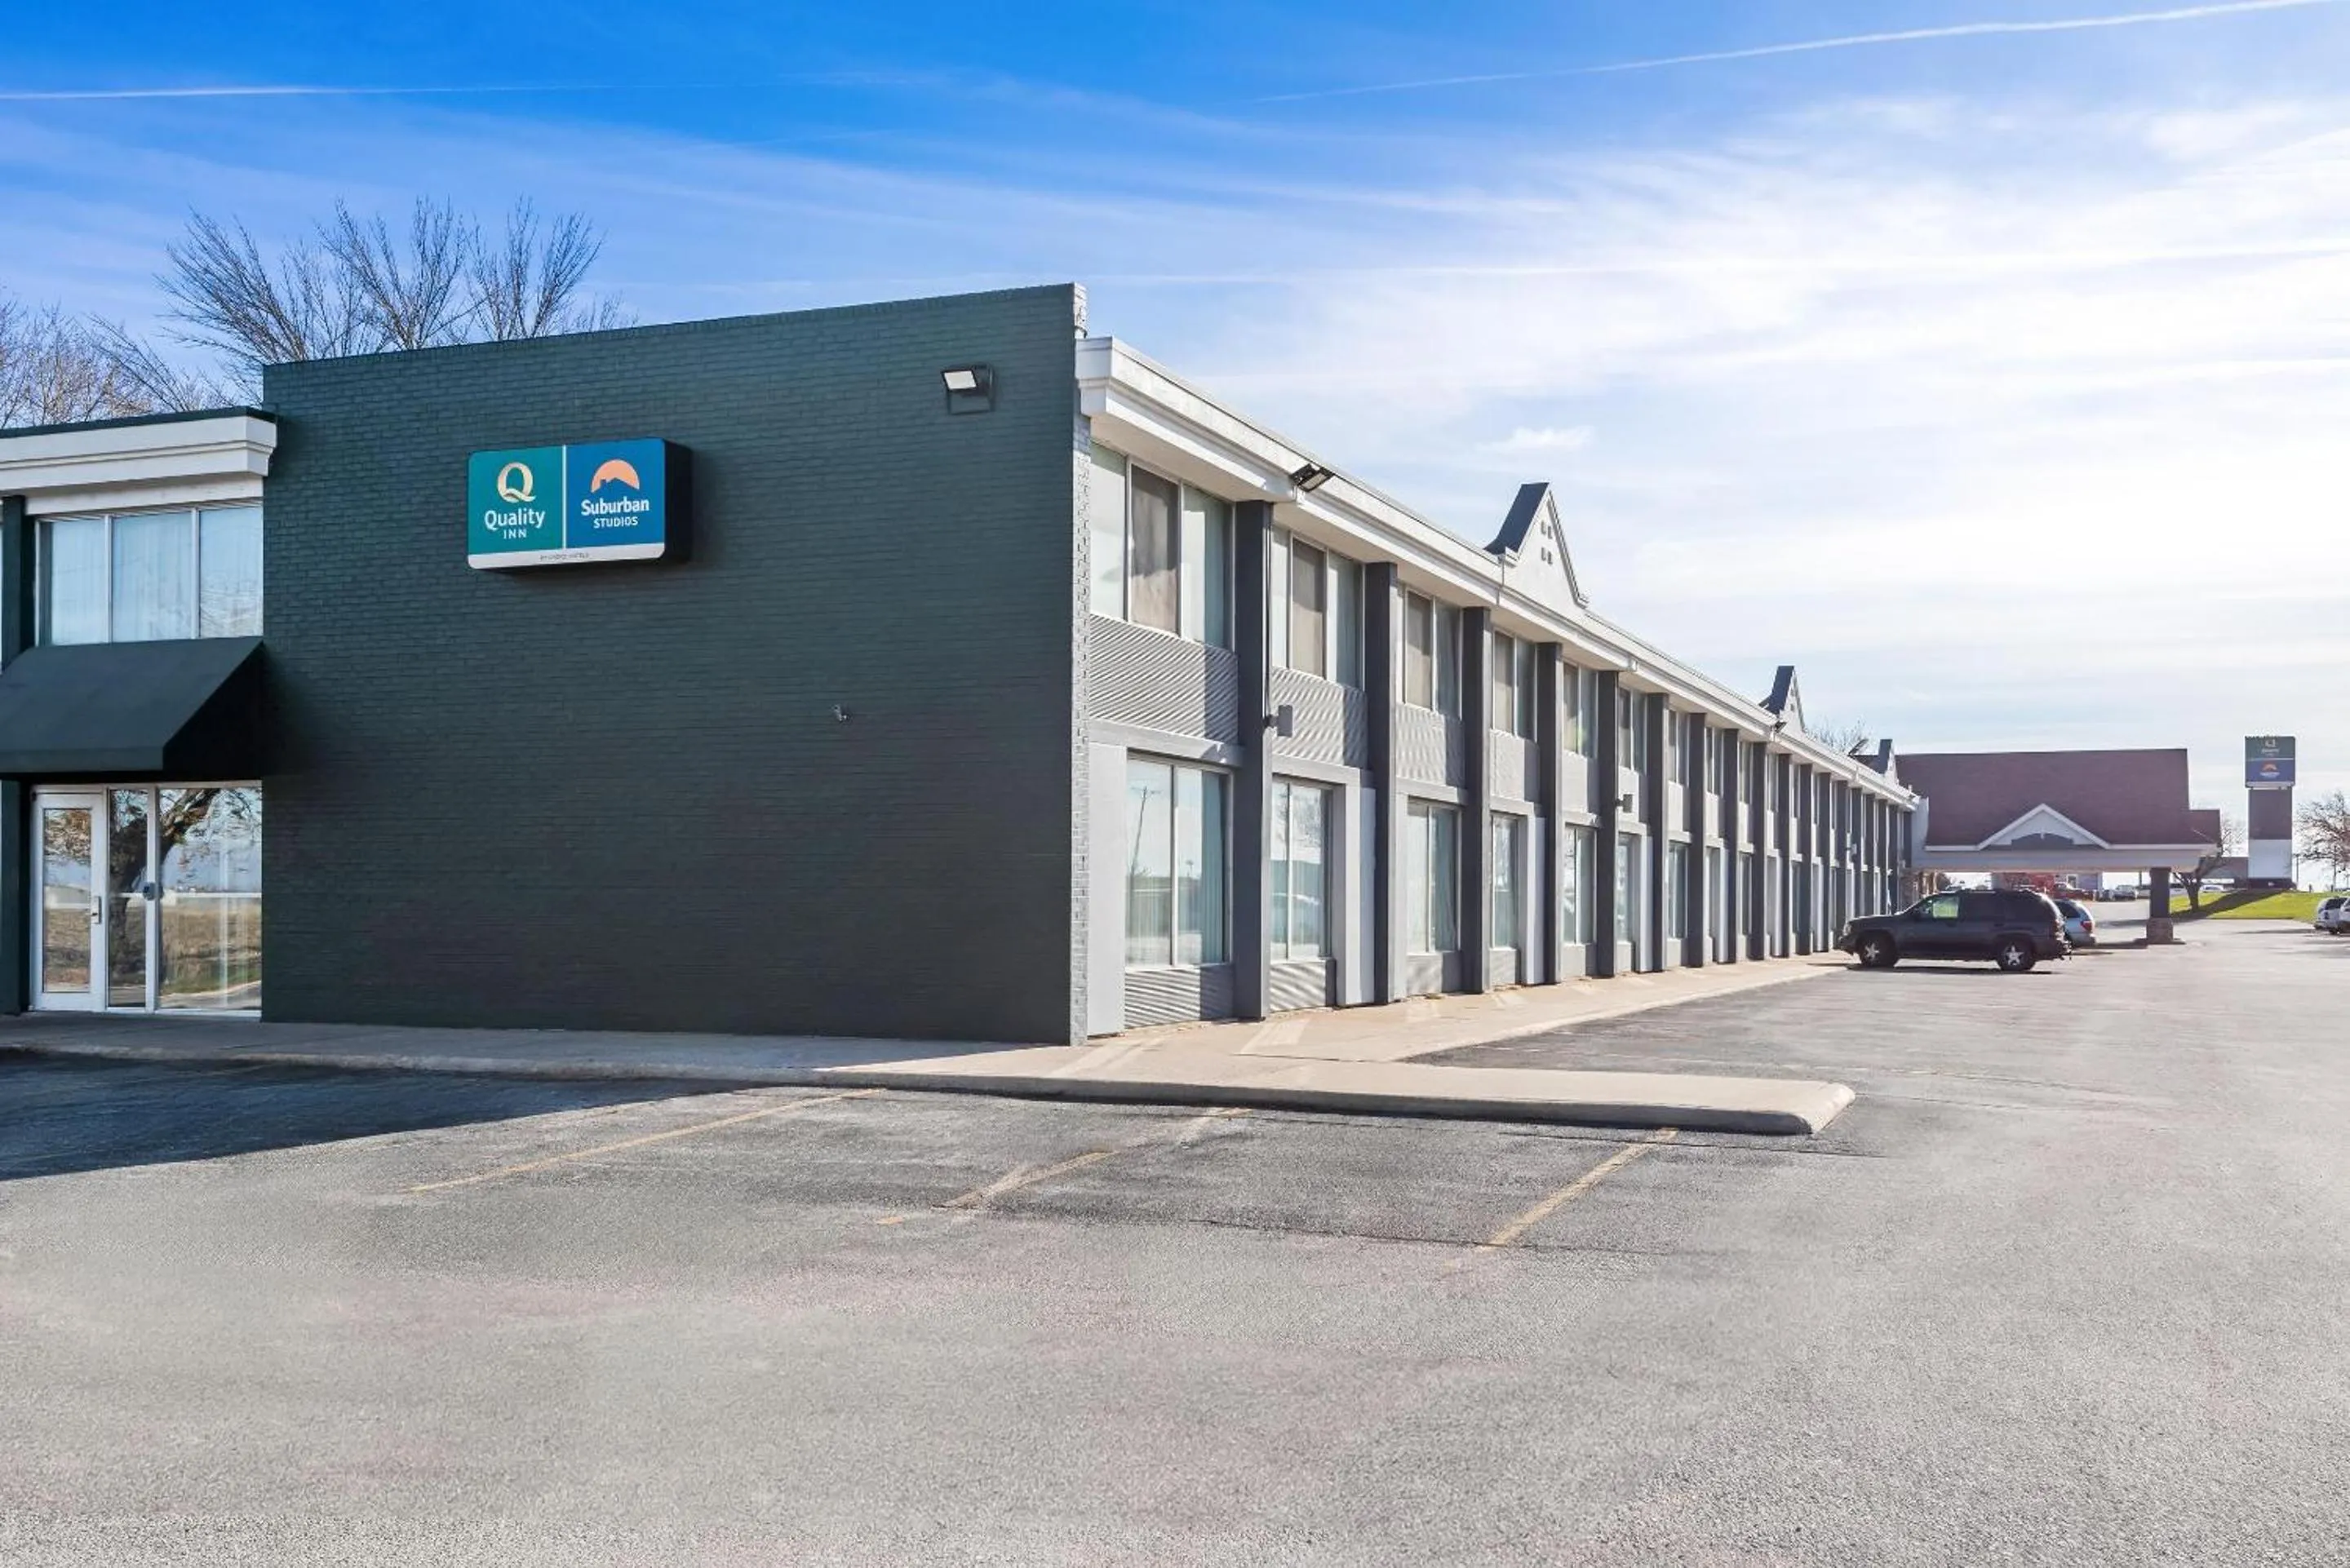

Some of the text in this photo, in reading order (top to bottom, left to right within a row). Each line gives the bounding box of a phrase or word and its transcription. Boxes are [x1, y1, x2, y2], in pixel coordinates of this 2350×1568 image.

[497, 462, 536, 503] Q
[581, 496, 650, 516] Suburban
[485, 507, 545, 530] Quality
[593, 516, 639, 529] STUDIOS
[503, 529, 527, 539] INN
